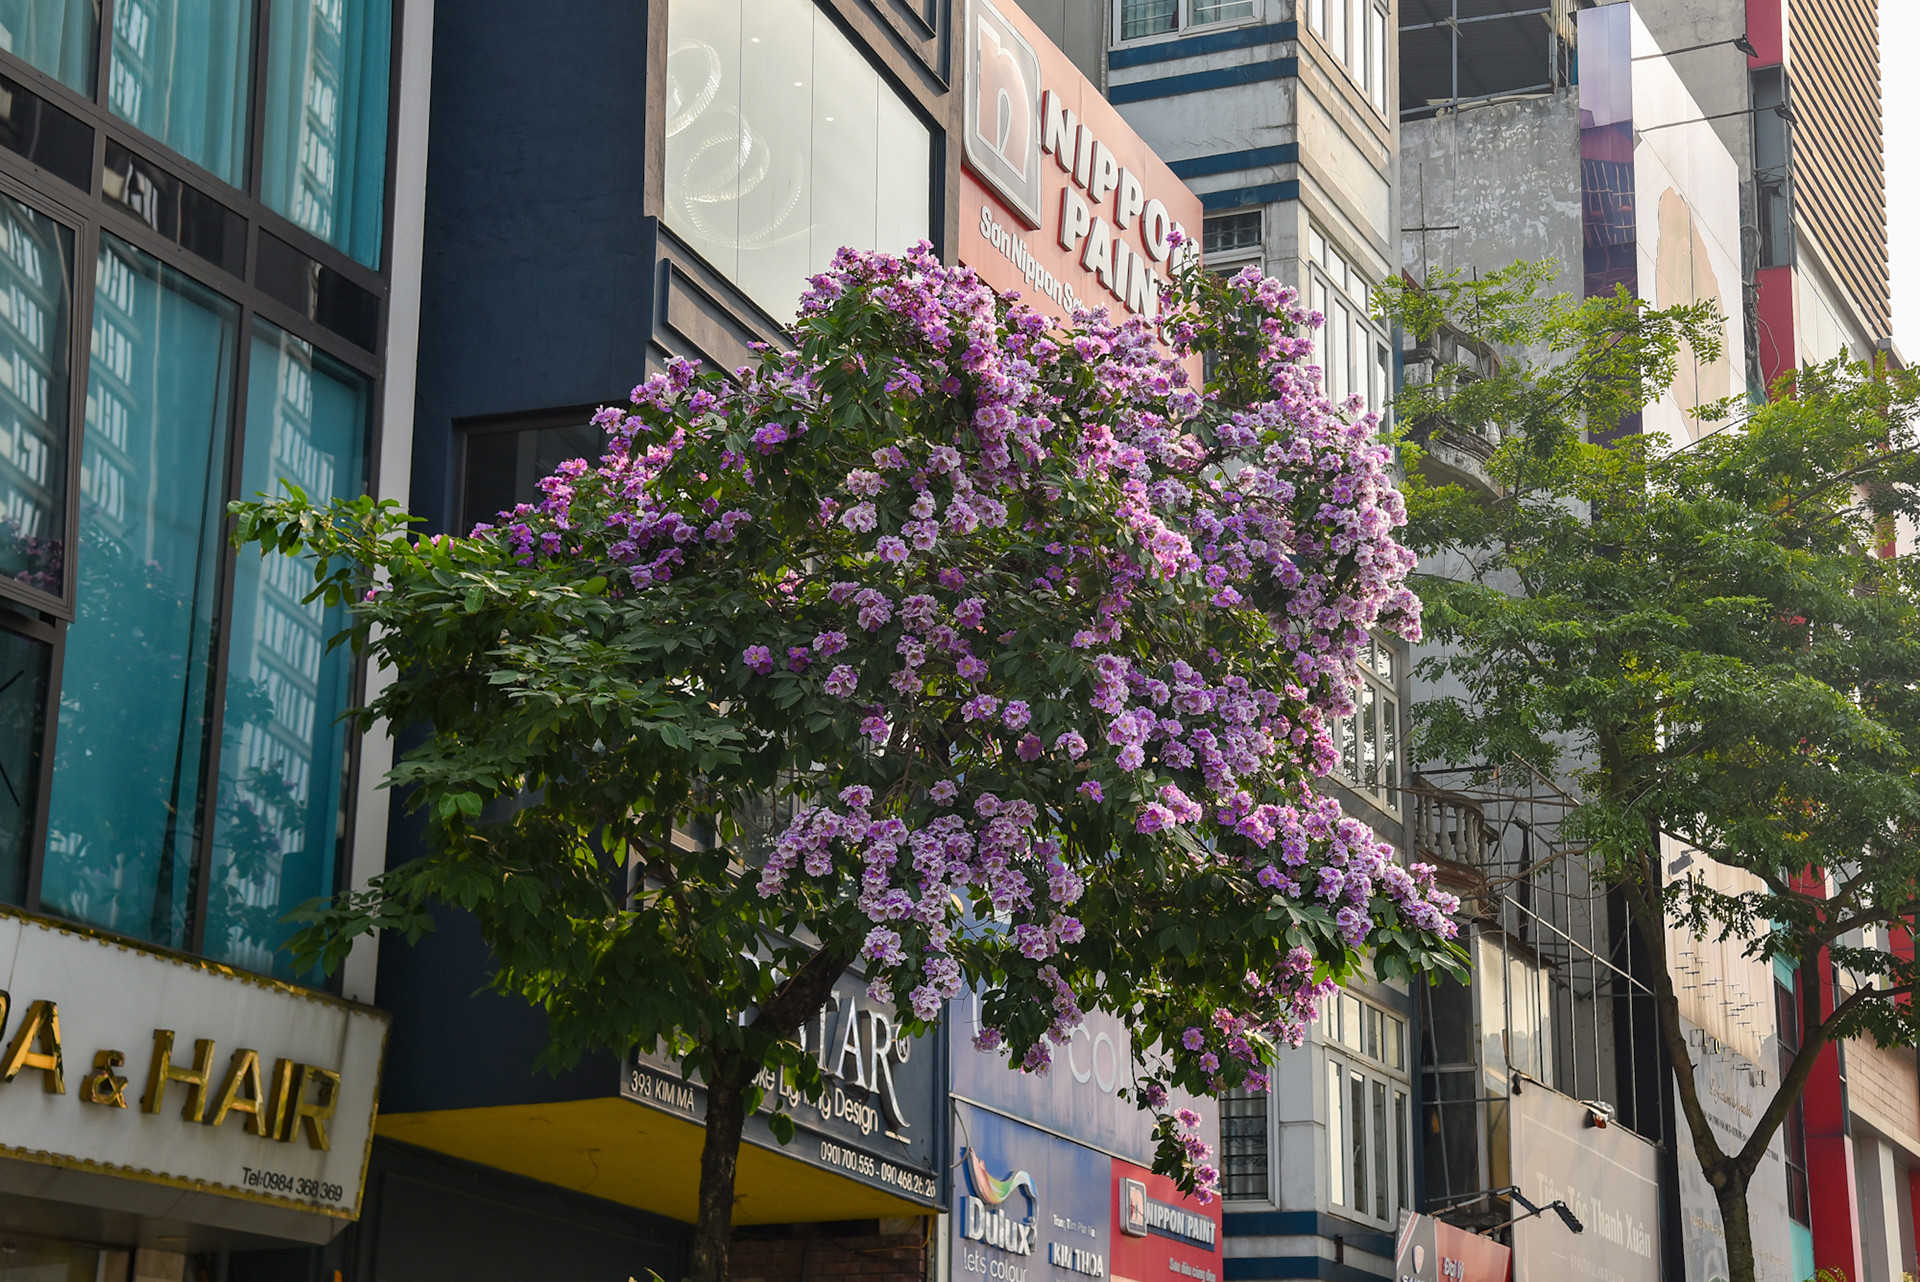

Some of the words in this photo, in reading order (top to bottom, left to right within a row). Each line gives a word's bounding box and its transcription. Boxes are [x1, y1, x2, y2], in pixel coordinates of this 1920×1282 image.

[1042, 89, 1199, 297] NIPPON
[1011, 233, 1062, 306] Nippon
[0, 990, 66, 1095] A
[79, 1049, 129, 1109] &
[140, 1028, 341, 1151] HAIR
[631, 1070, 651, 1096] 393
[654, 1078, 675, 1106] KIM
[835, 1087, 879, 1135] Design
[296, 1177, 319, 1198] 368
[320, 1182, 343, 1202] 369
[965, 1195, 1031, 1257] Dulux
[1146, 1202, 1185, 1236] NIPPON
[1186, 1214, 1216, 1245] PAINT
[1567, 1185, 1588, 1229] Tóc
[1590, 1195, 1624, 1247] Thanh
[1625, 1213, 1651, 1259] Xuân
[989, 1258, 1028, 1282] colour
[1074, 1248, 1105, 1279] THOA
